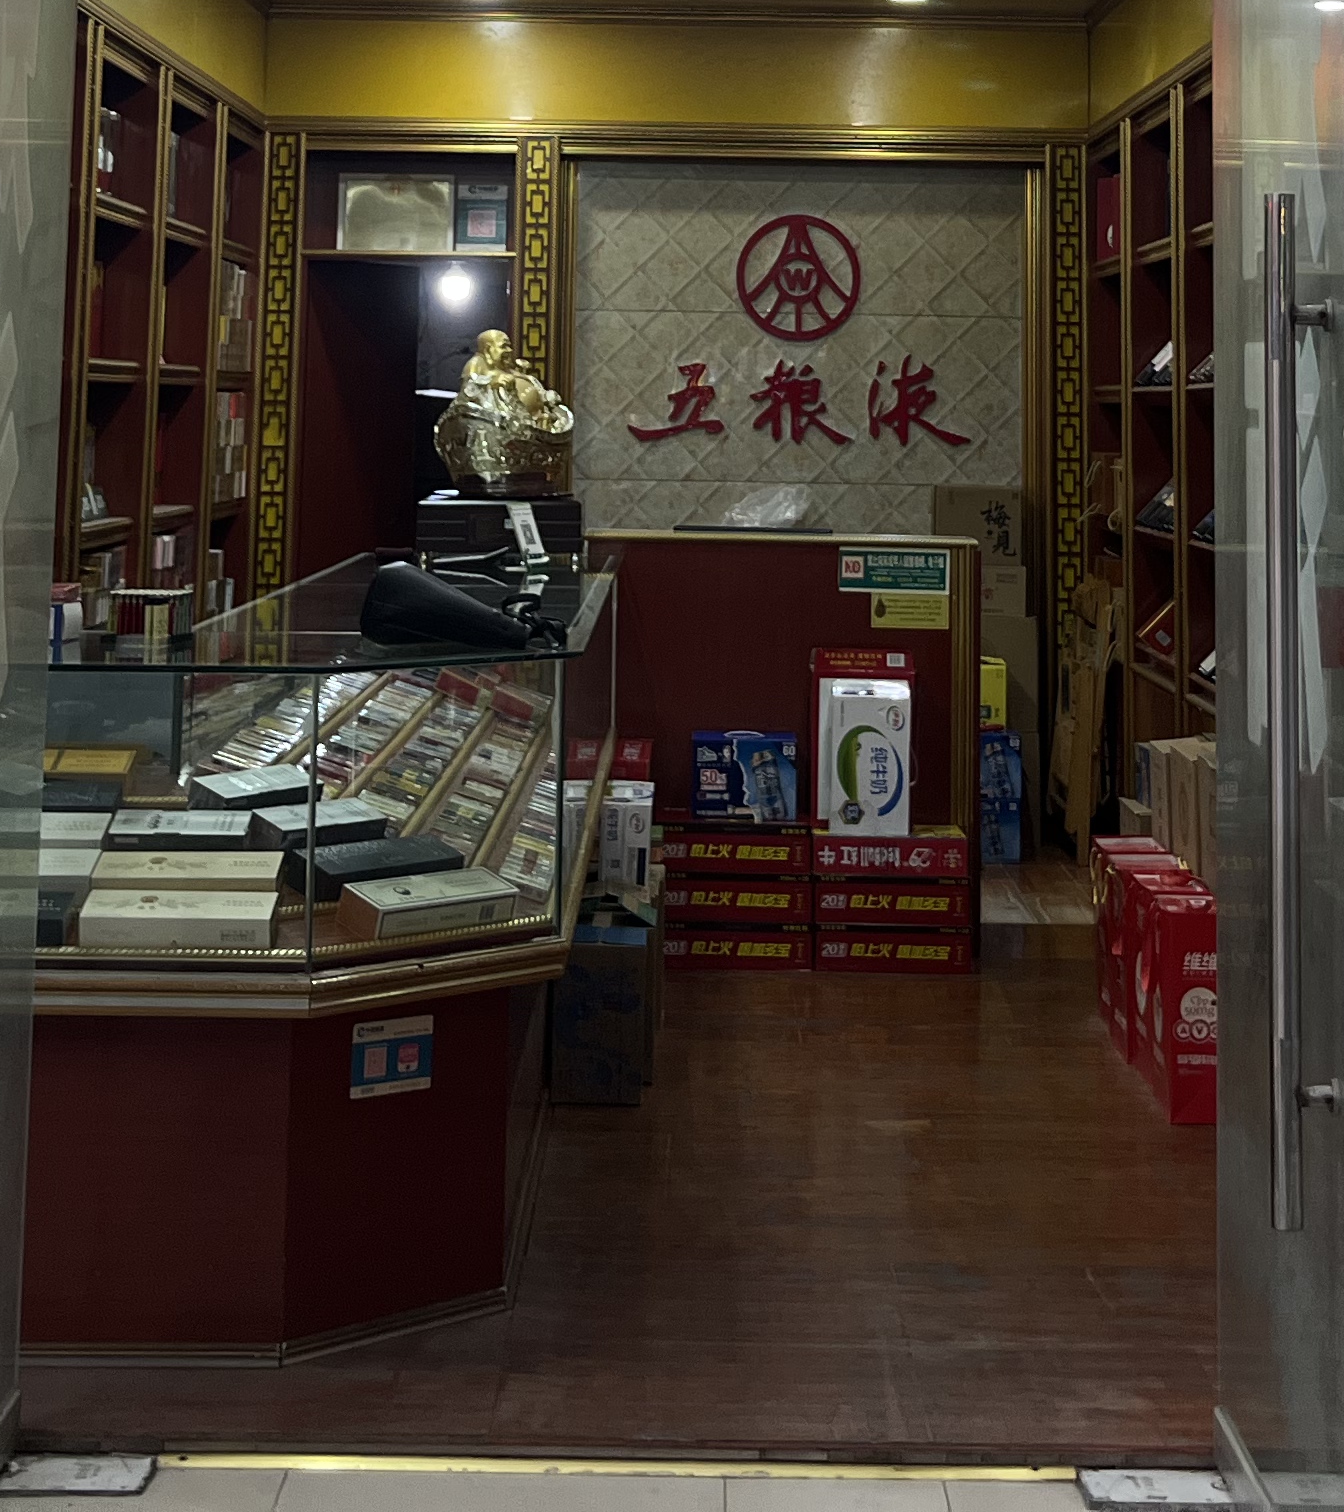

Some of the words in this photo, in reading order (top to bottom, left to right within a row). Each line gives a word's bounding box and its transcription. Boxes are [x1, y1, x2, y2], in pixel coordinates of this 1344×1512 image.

[628, 354, 971, 447] 五粮液
[870, 746, 888, 796] 纯牛奶
